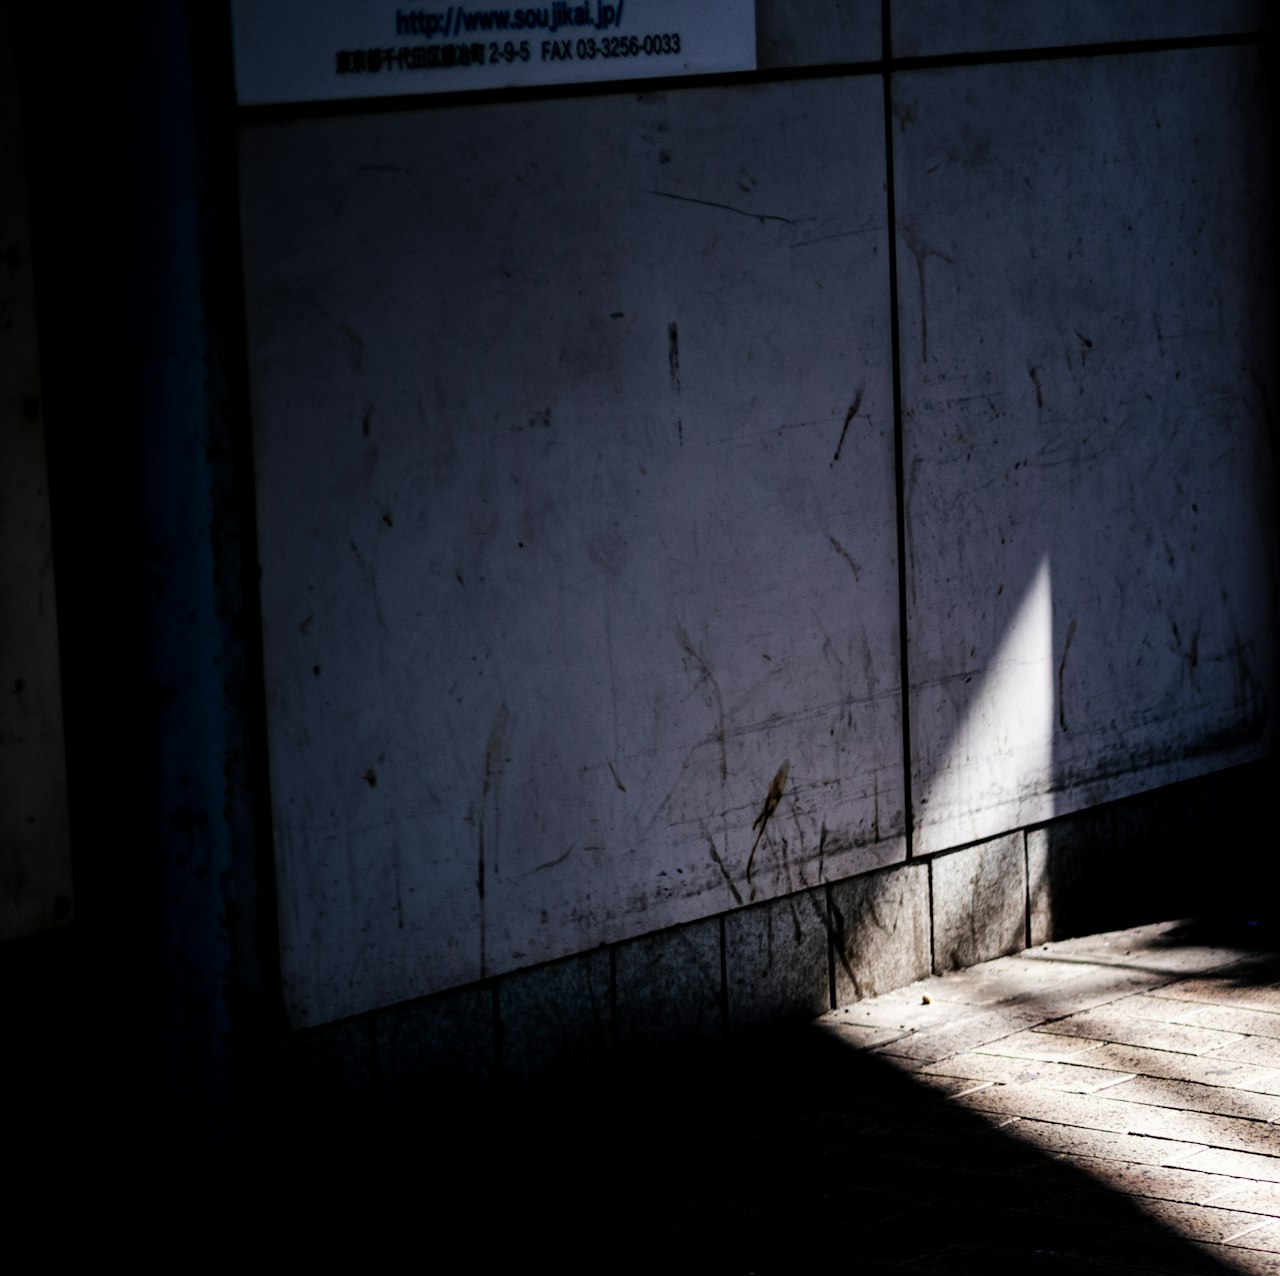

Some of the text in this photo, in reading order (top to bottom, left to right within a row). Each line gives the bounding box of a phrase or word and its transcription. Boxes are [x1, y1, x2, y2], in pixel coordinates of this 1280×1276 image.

[397, 0, 624, 38] http://www.soujikai.jp/
[489, 41, 530, 62] 2-9-5
[541, 39, 573, 60] FAX
[577, 34, 681, 59] 03-3256-0033
